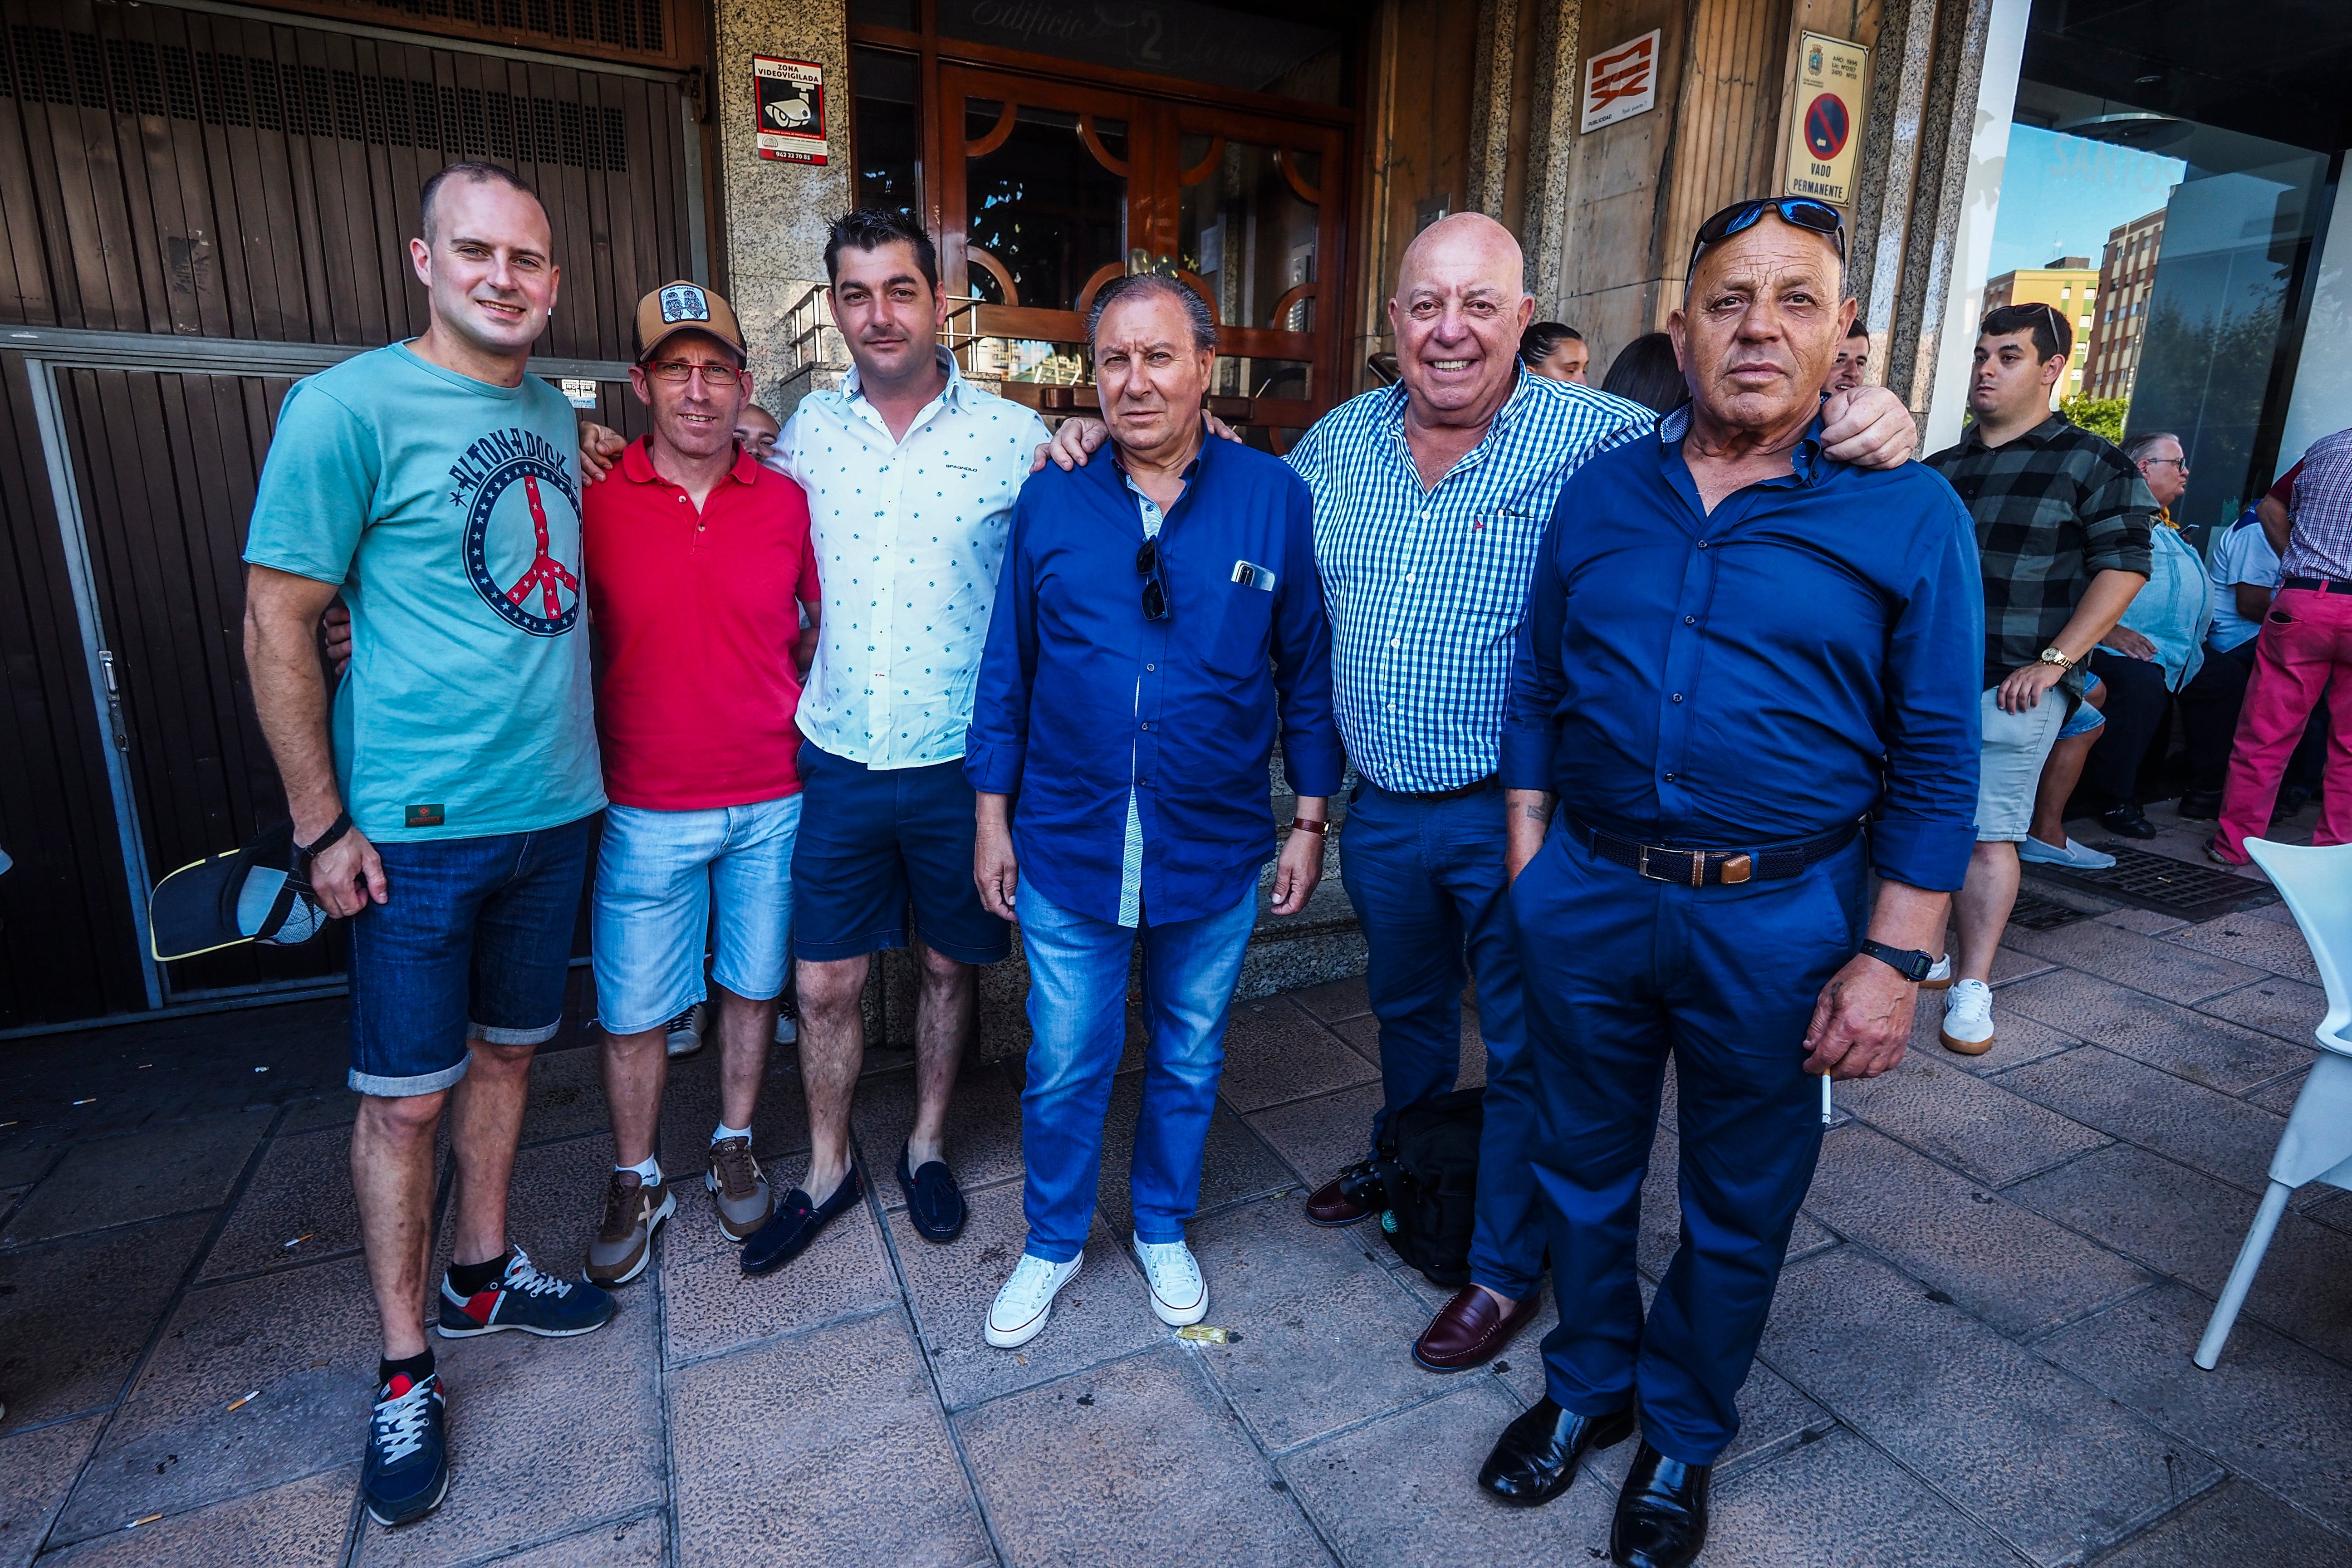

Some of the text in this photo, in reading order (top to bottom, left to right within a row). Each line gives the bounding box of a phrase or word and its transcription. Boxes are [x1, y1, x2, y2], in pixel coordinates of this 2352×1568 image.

[1141, 12, 1164, 60] 2
[758, 68, 818, 83] VIDEOVIGILADA
[777, 64, 799, 73] ZONA
[1588, 114, 1612, 127] PUBLICIDAD
[1811, 162, 1831, 178] VADO
[2049, 132, 2181, 198] SANTOS
[1793, 179, 1843, 199] PERMANENTE
[448, 428, 572, 491] ALTONADOCK
